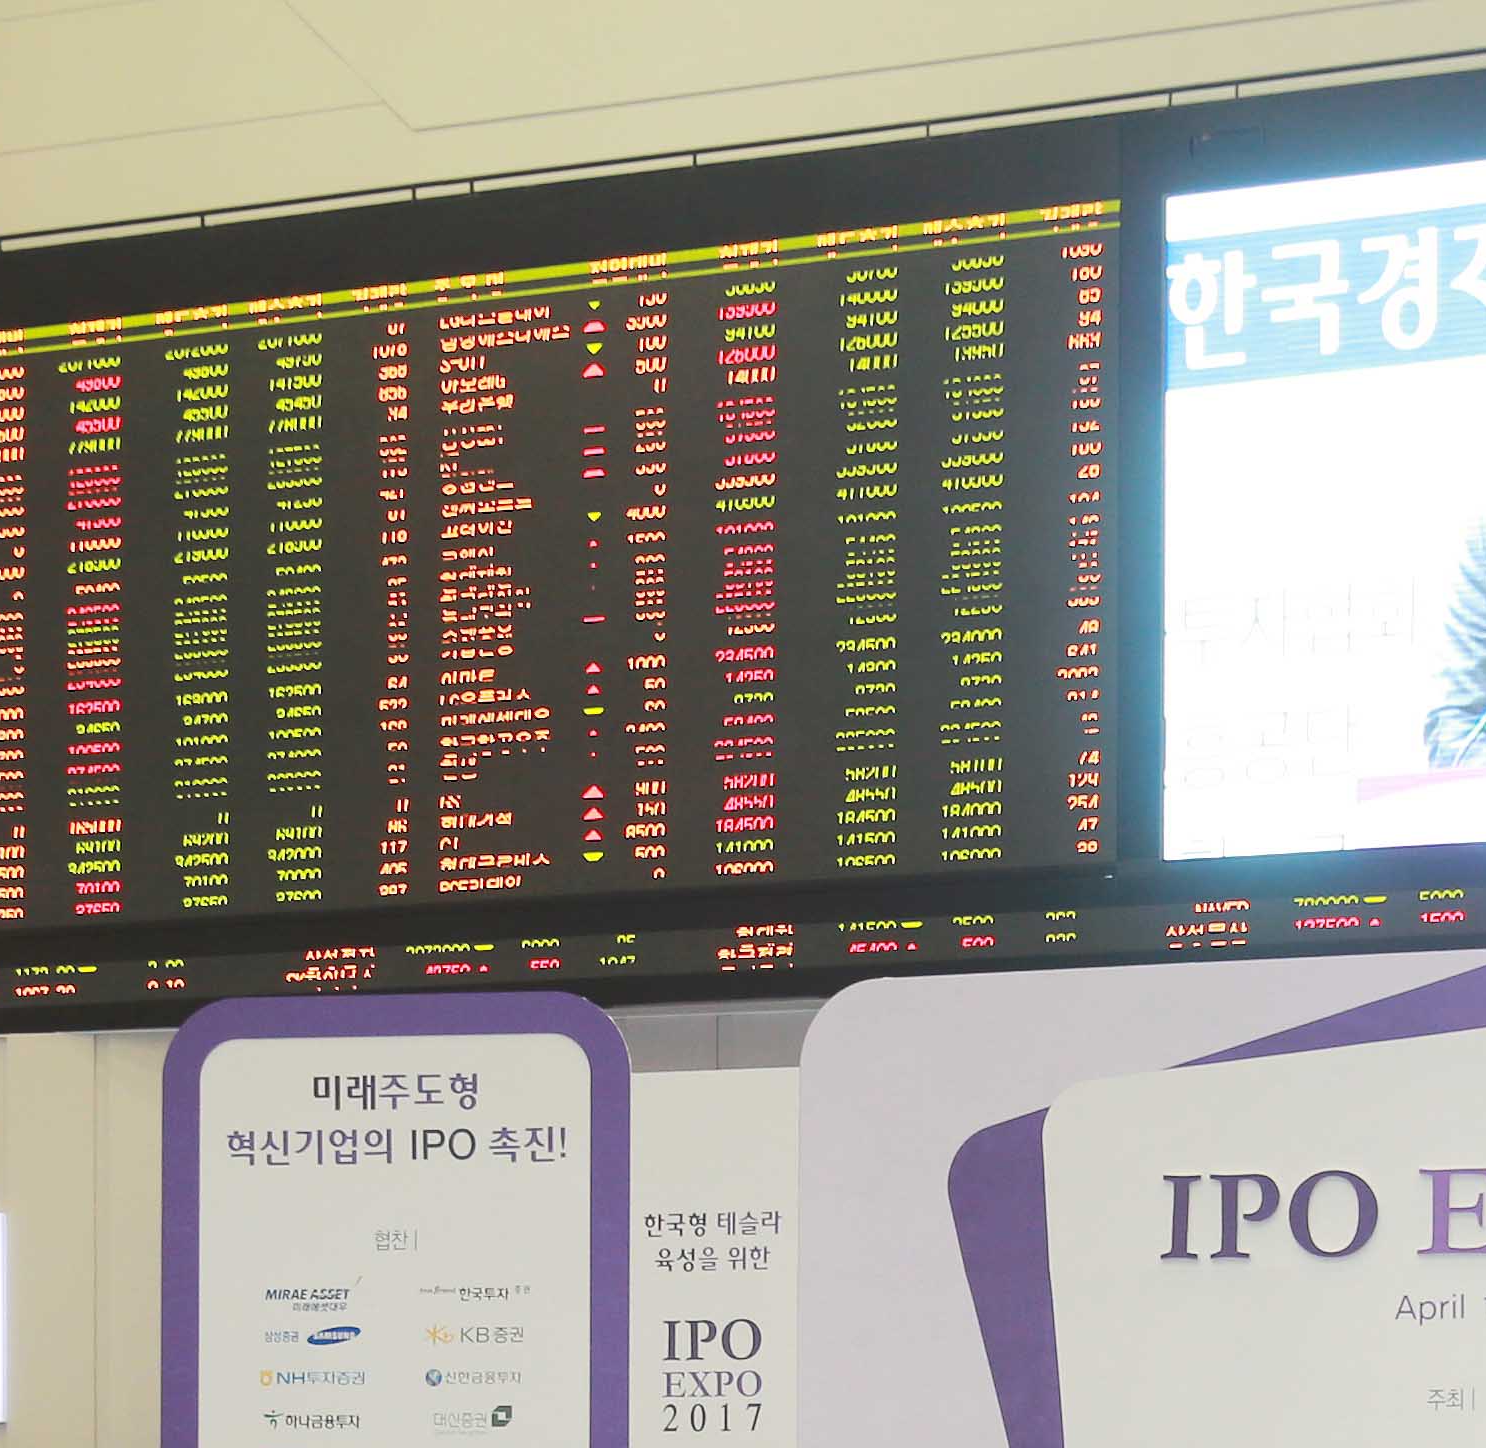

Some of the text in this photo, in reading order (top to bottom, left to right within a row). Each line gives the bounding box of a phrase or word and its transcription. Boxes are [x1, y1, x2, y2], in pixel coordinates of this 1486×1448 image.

[314, 1073, 477, 1110] 미래주도형
[227, 1126, 565, 1165] 혁신기업의 IPO 촉진!
[645, 1211, 781, 1237] 한국형 테슬라
[1160, 1167, 1381, 1261] IPO
[375, 1230, 408, 1251] 협찬
[655, 1246, 770, 1272] 육성을 위한
[266, 1289, 349, 1300] MIRAE ASSET
[460, 1288, 508, 1301] 한국투자
[1395, 1294, 1464, 1326] April
[461, 1327, 523, 1343] KB 증권
[663, 1319, 761, 1360] IPO
[277, 1372, 364, 1385] NH투자증권
[445, 1371, 521, 1384] 신한금융투자
[663, 1371, 761, 1397] EXPO
[1427, 1389, 1463, 1410] 주최
[286, 1415, 359, 1429] 하나금융투자
[664, 1404, 761, 1432] 2017
